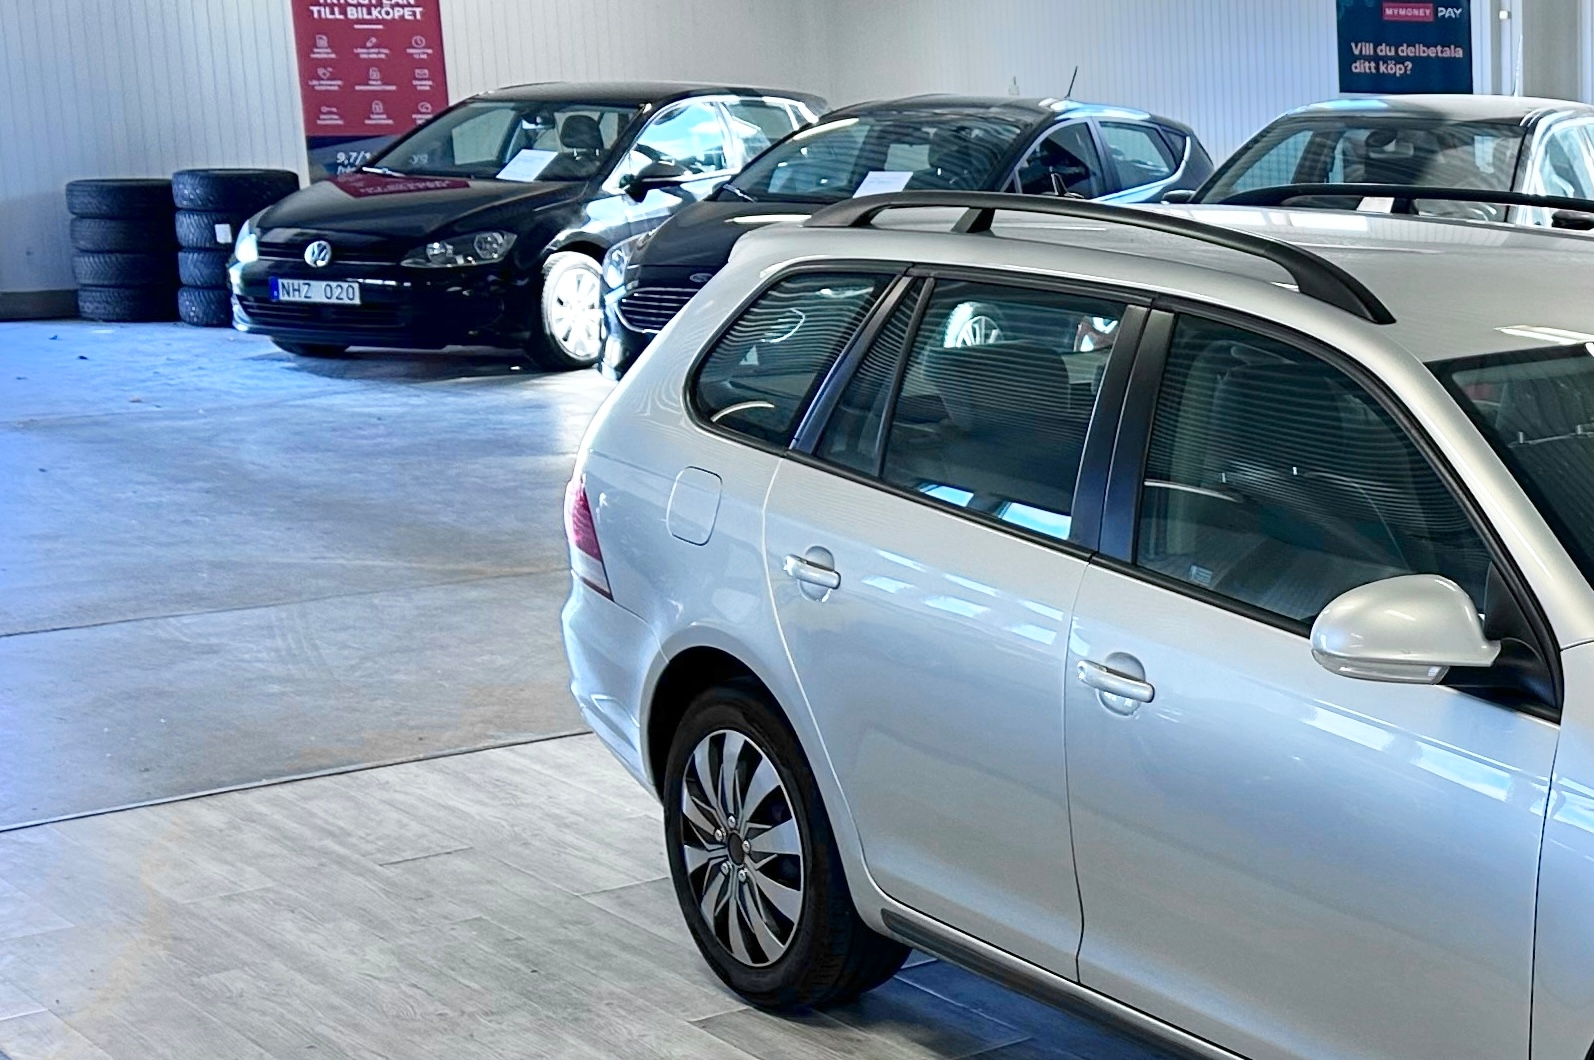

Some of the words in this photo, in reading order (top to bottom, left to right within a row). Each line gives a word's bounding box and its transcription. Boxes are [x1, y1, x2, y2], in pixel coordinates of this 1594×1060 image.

[310, 6, 344, 19] TILL
[347, 4, 423, 20] BILKÖPET
[1385, 7, 1431, 16] MYMONEY
[1437, 7, 1462, 19] PAY
[1351, 42, 1374, 56] Vill
[1377, 43, 1395, 56] du
[1398, 44, 1463, 58] delbetala
[1351, 60, 1376, 73] ditt
[1379, 61, 1413, 77] köp?
[281, 281, 312, 299] NHZ
[323, 283, 356, 301] 020
